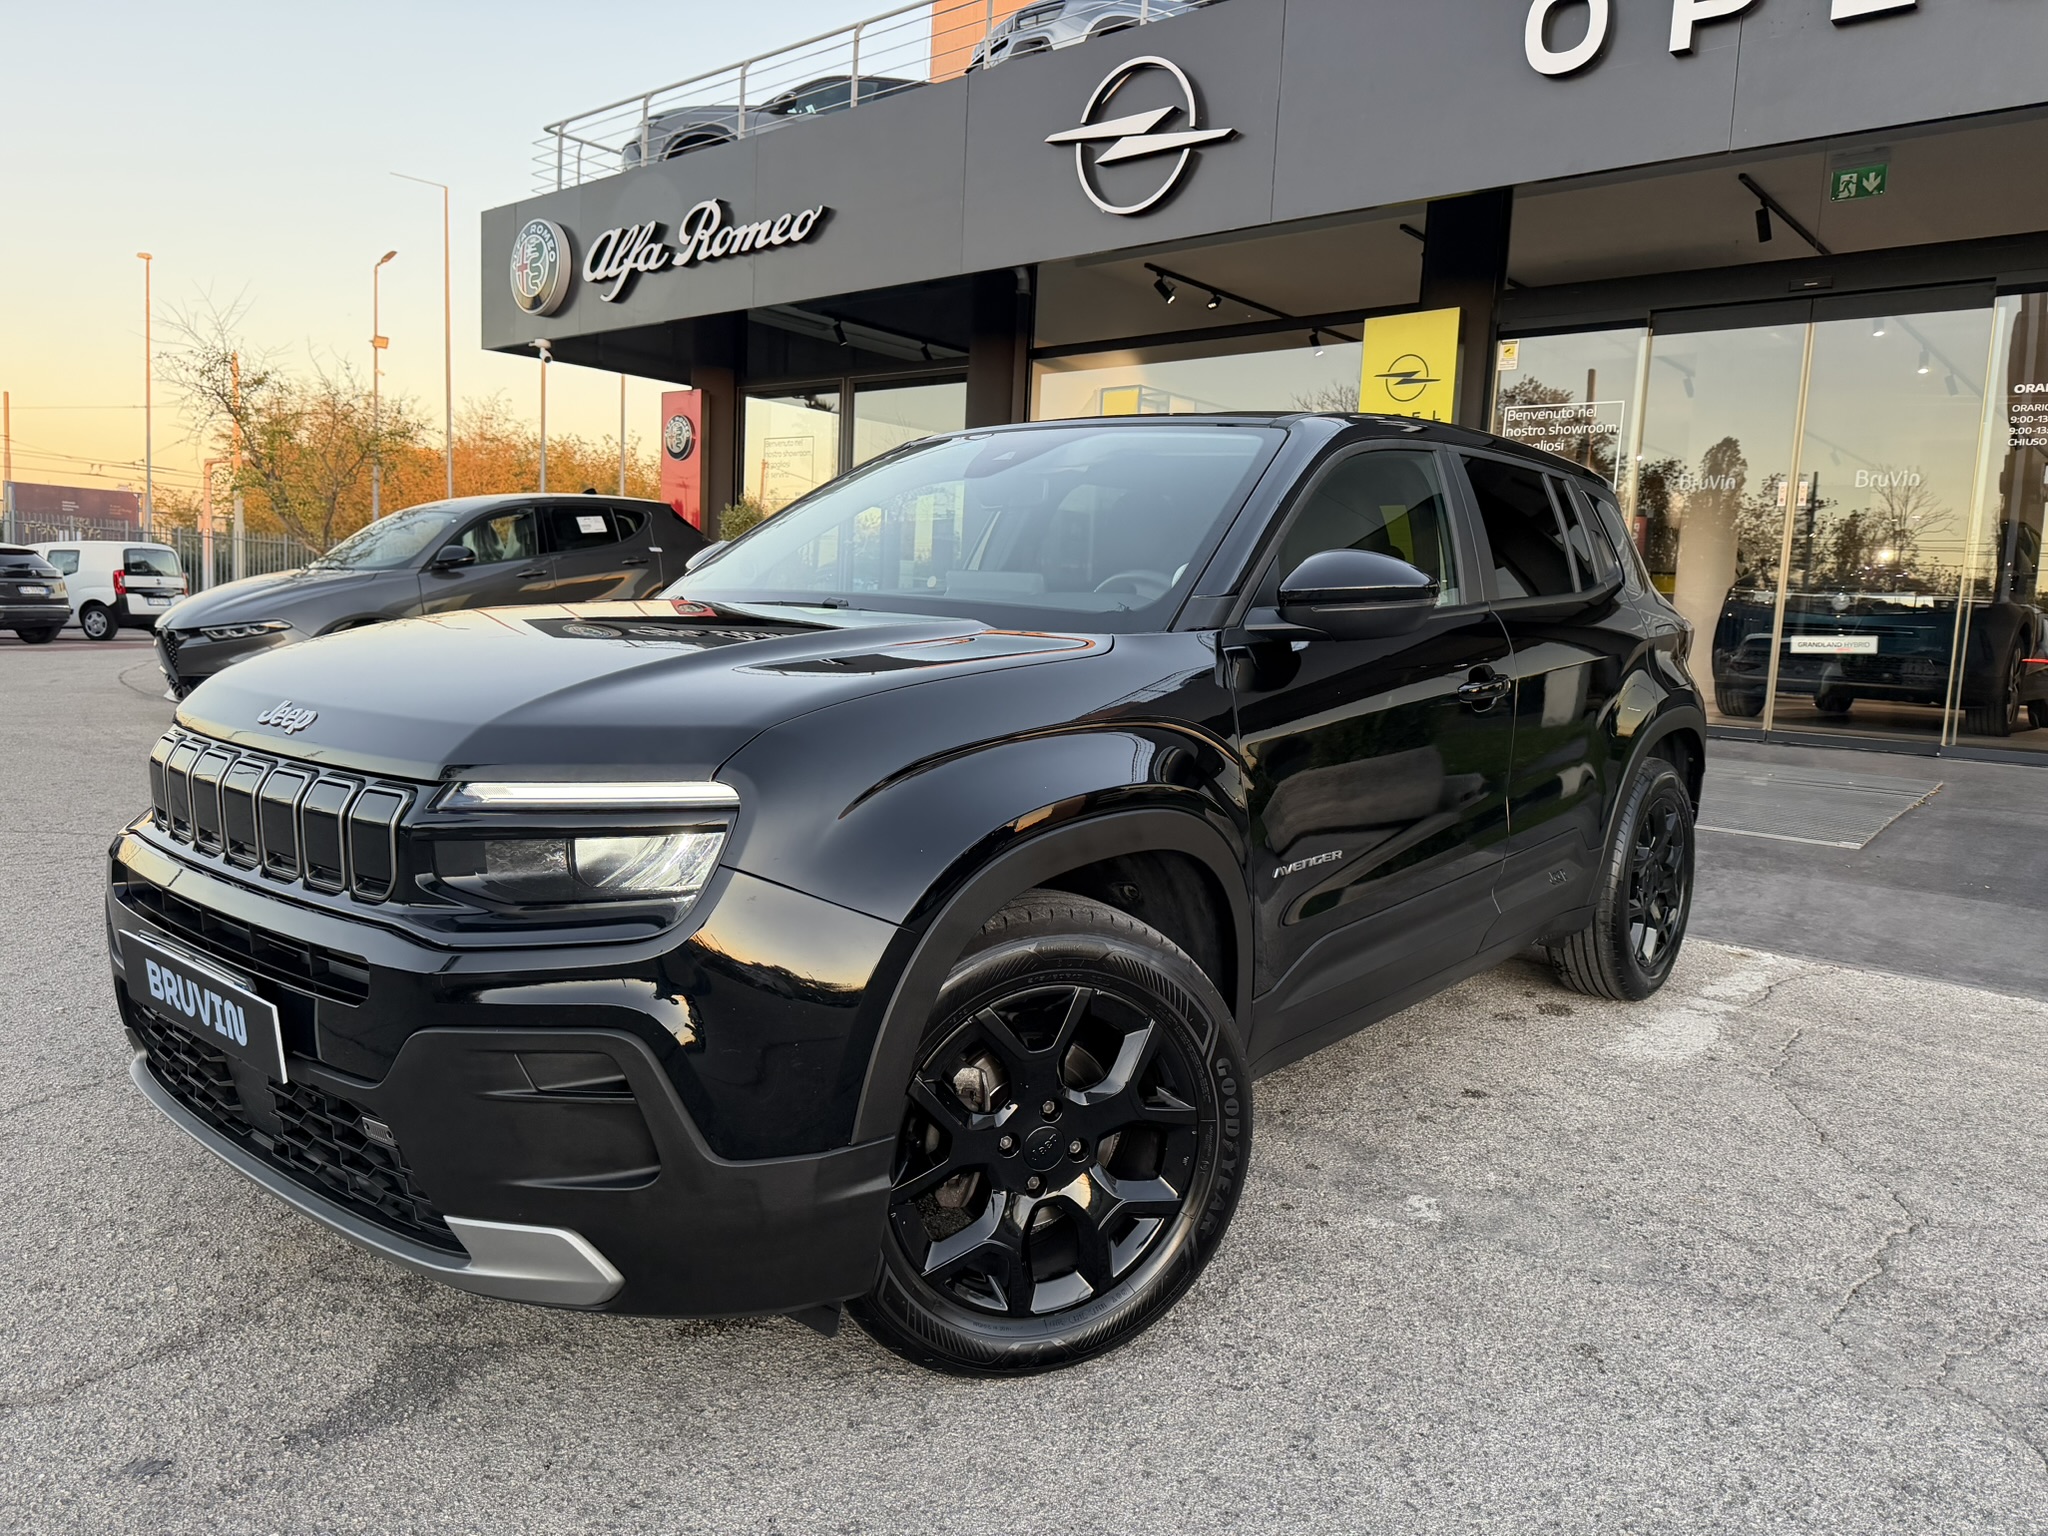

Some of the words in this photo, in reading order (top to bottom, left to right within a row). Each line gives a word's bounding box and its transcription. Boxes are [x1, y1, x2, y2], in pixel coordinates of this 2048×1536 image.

[529, 224, 556, 263] ROMEO
[582, 220, 669, 302] Alfa
[672, 198, 823, 267] Romeo
[1507, 408, 1575, 422] Benvenuto
[1577, 405, 1597, 418] nel
[1505, 425, 1546, 437] nostro
[1548, 423, 1620, 436] showroom,
[2007, 437, 2048, 446] CHIUSO
[1679, 474, 1736, 491] BruVin
[1854, 470, 1920, 488] BruVin
[257, 700, 318, 735] Jeep
[1272, 849, 1343, 879] AVENGER
[145, 958, 248, 1047] BRUVIN
